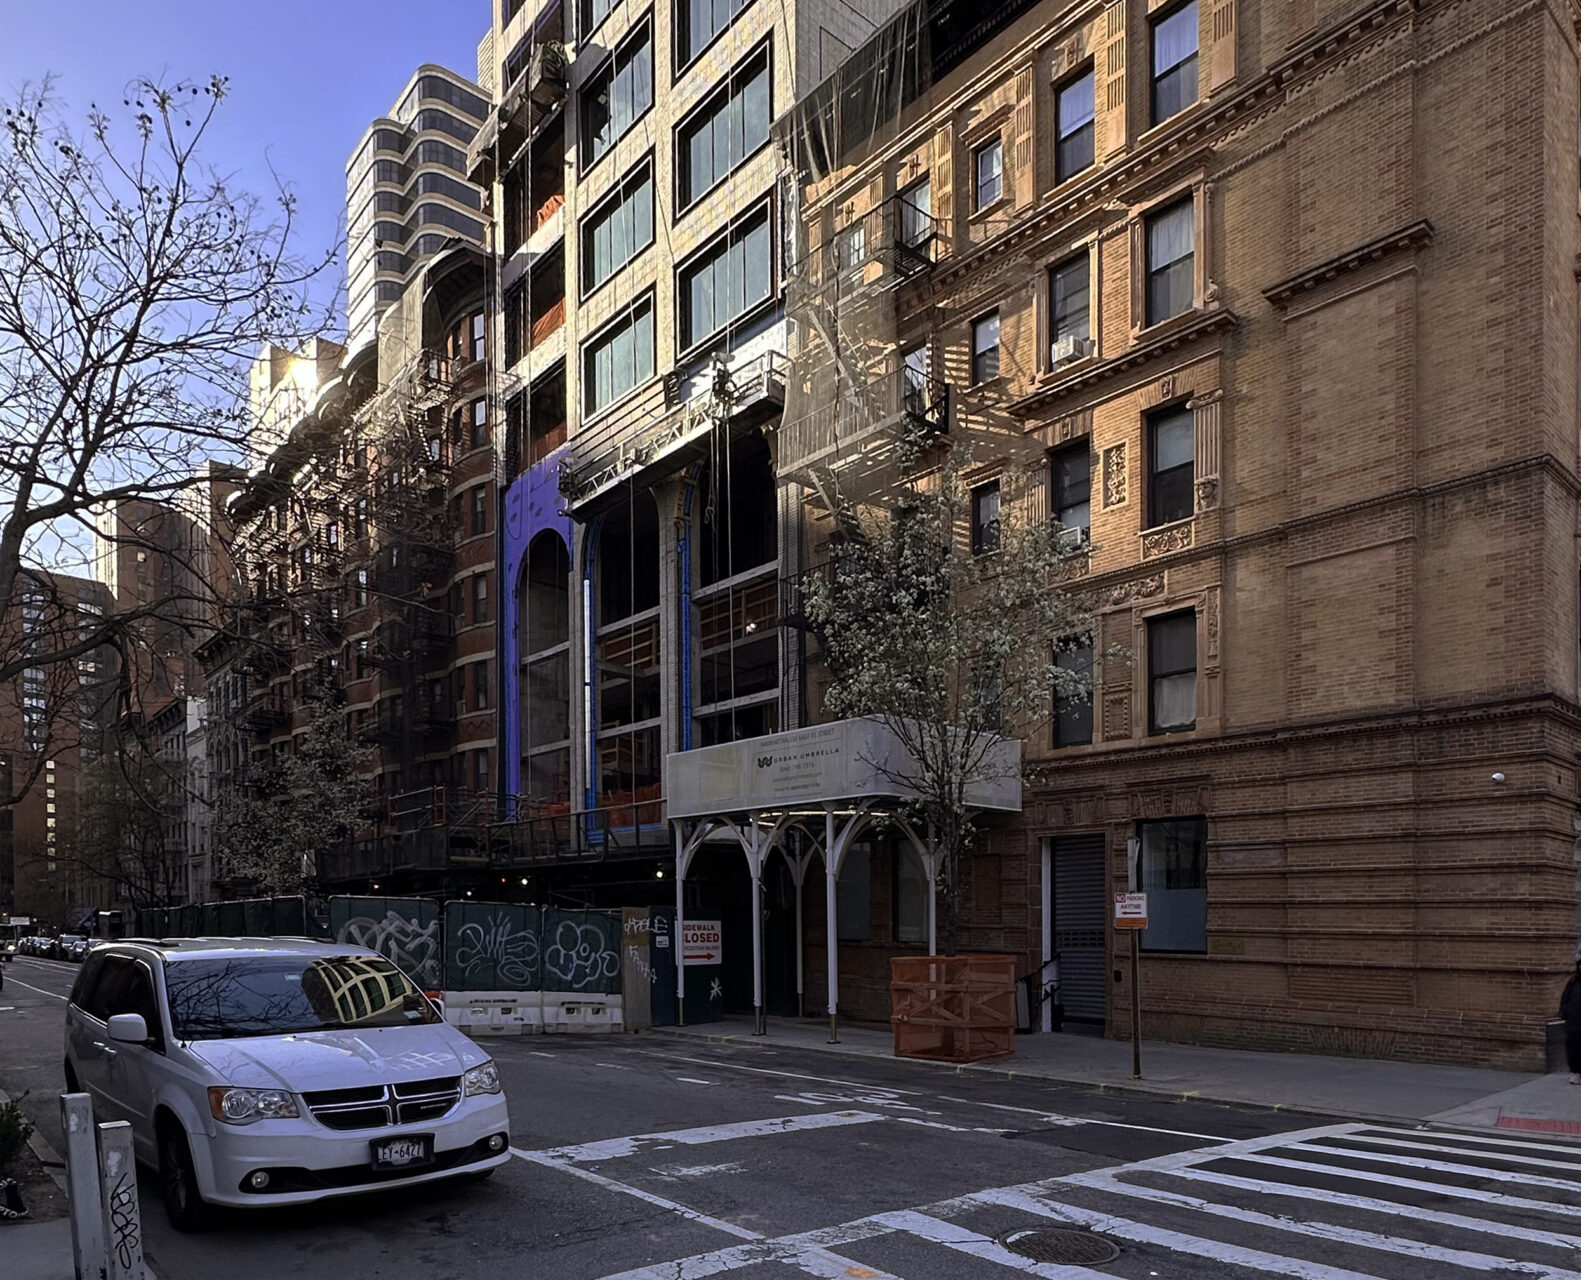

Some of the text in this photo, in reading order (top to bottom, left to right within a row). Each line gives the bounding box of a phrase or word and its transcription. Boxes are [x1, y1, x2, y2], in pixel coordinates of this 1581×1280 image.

[774, 748, 840, 763] URBAN UMBRELLA
[683, 933, 719, 943] LOSED
